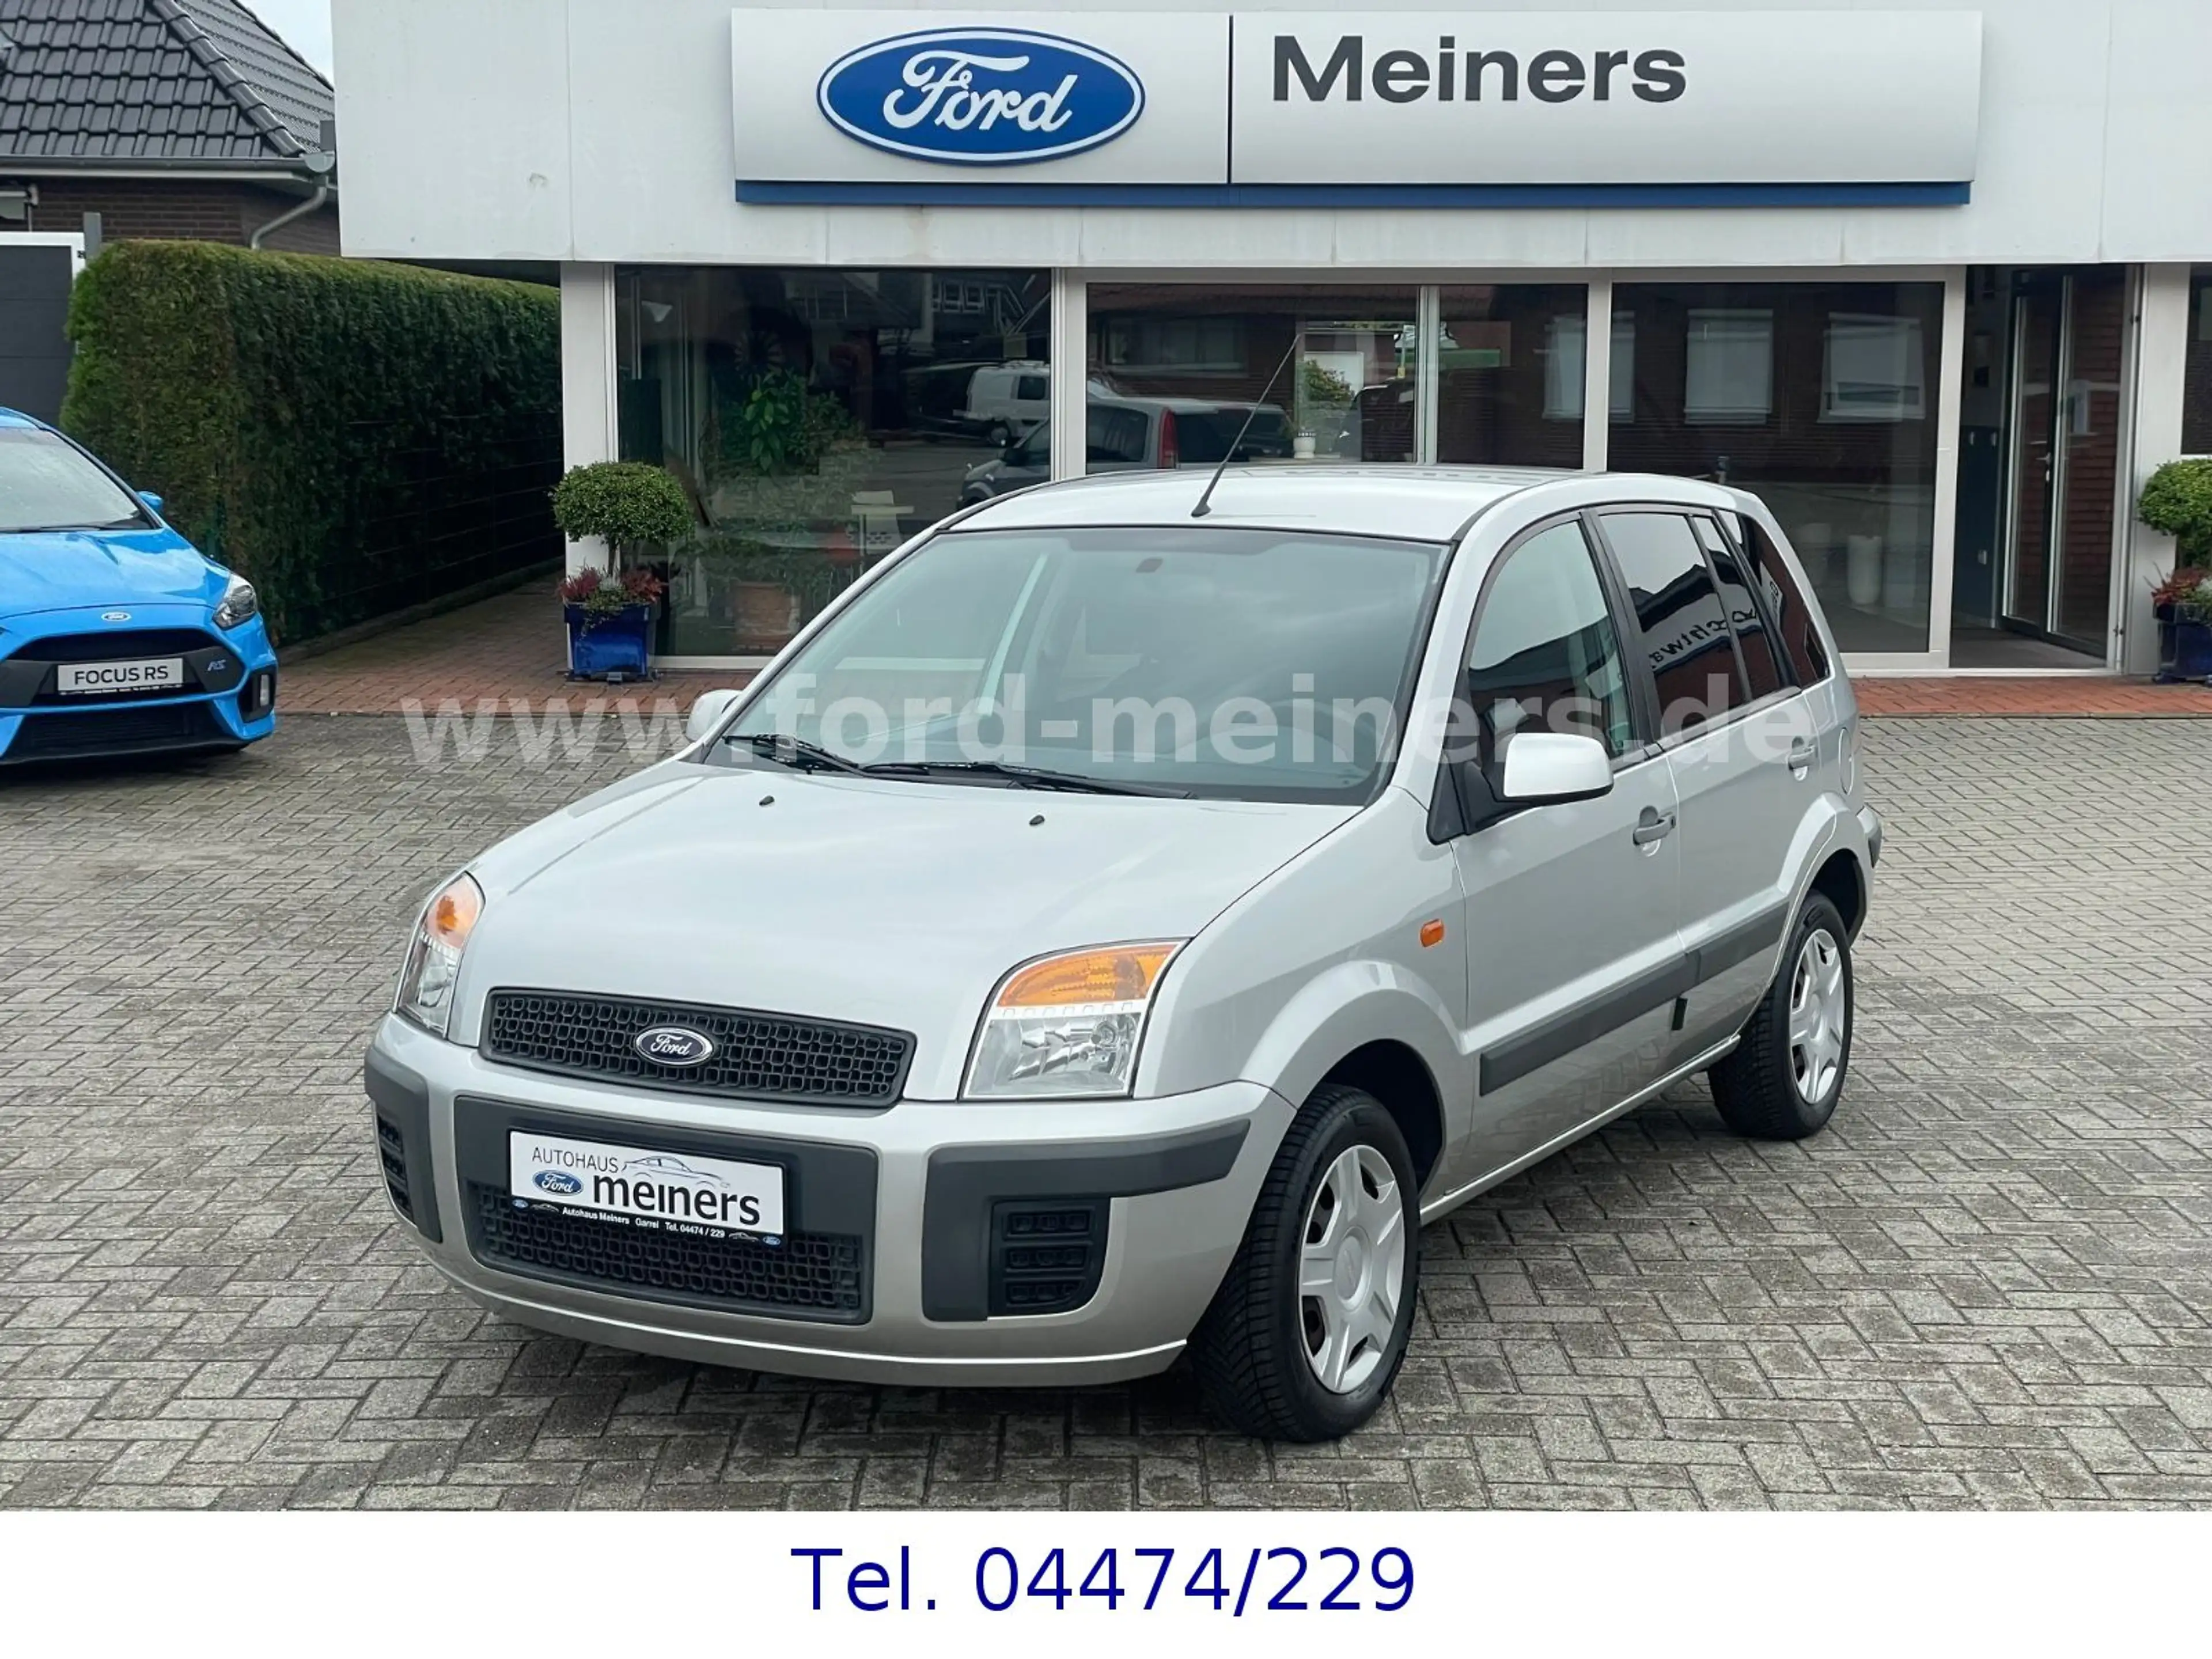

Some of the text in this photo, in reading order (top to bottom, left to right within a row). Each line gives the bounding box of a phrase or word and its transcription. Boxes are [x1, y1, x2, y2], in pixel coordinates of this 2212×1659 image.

[1273, 35, 1687, 104] Meiners
[882, 50, 1078, 132] Ford
[74, 665, 168, 685] FOCUS RS
[650, 1033, 692, 1056] Ford
[532, 1147, 619, 1173] AUTOHAUS
[541, 1173, 573, 1193] Ford
[593, 1175, 760, 1226] meiners
[562, 1206, 598, 1220] Autohaus
[599, 1211, 630, 1225] Meiners
[664, 1221, 678, 1232] Tel.
[679, 1224, 703, 1236] 04474
[710, 1228, 726, 1238] 229
